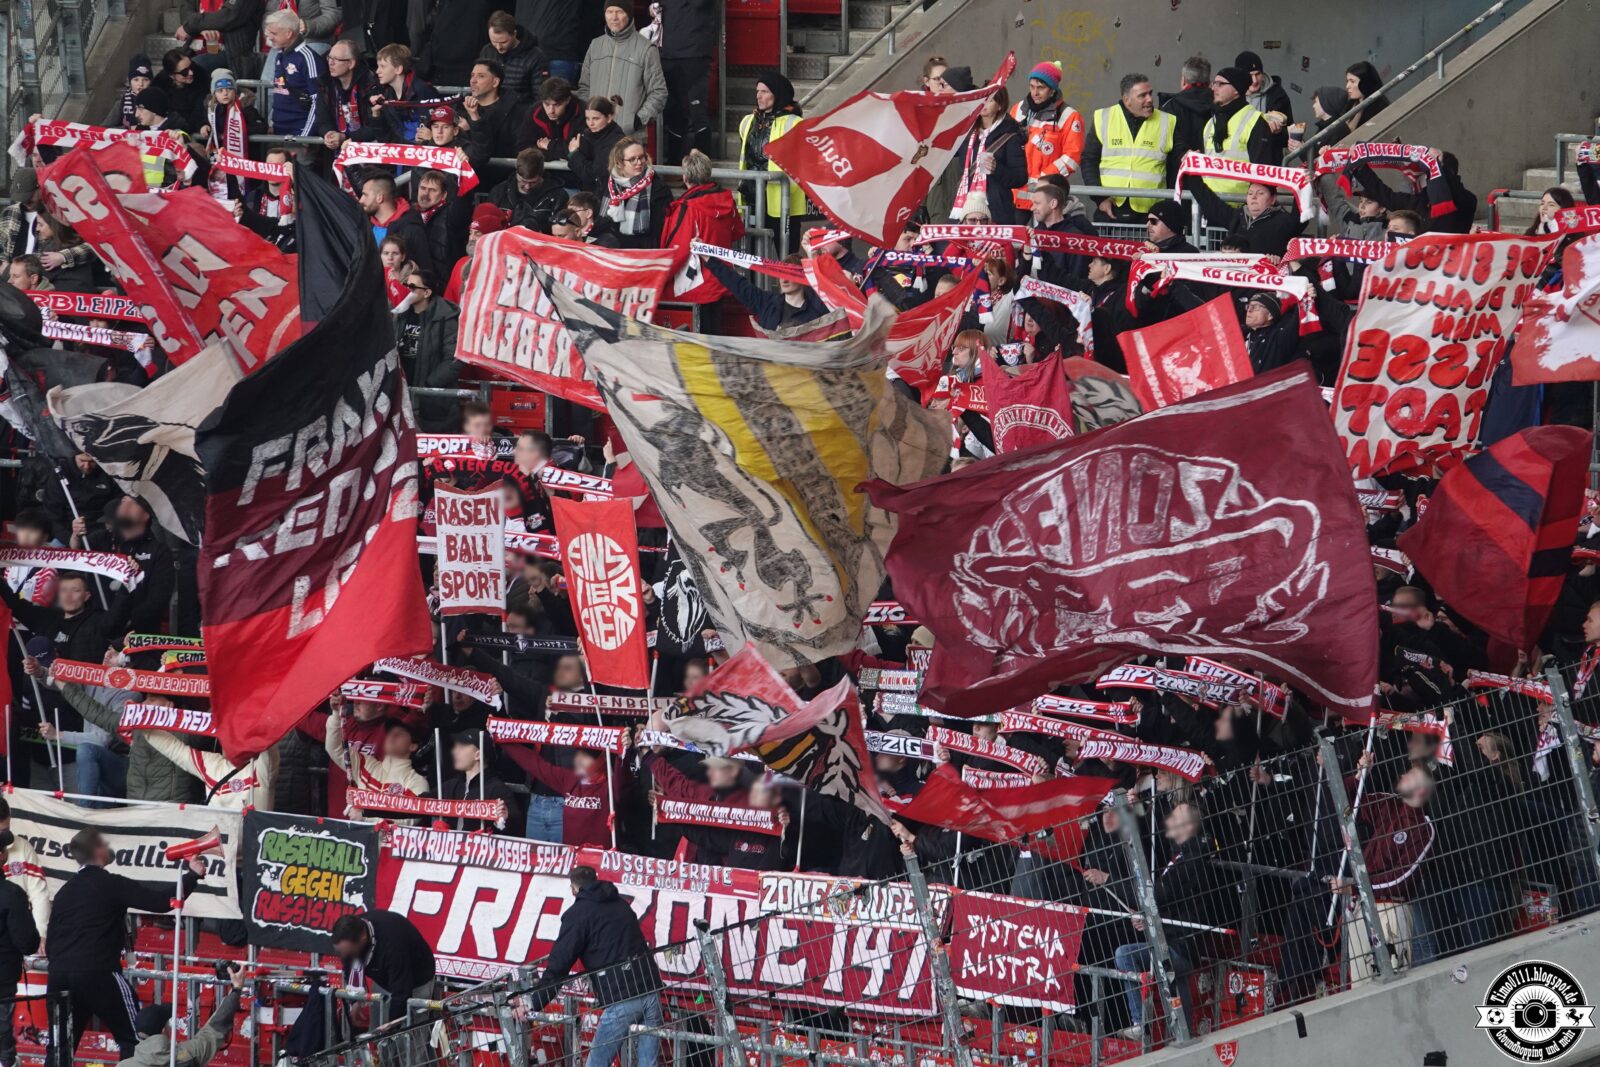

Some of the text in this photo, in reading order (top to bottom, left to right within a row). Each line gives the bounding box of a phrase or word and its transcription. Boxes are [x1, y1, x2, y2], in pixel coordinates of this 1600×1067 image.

[40, 125, 105, 143] ROTEN
[227, 156, 256, 171] ROTEN
[346, 146, 400, 158] ROTEN
[1368, 143, 1400, 157] ROTEN
[1205, 157, 1252, 174] ROTEN
[1257, 165, 1306, 188] BULLEN
[971, 226, 1013, 239] CLUB
[1299, 239, 1330, 256] RB
[76, 296, 144, 318] LEIPZ
[417, 438, 469, 455] SPORT
[437, 498, 500, 526] RASEN
[445, 534, 493, 563] BALL
[567, 533, 631, 582] EINS
[441, 570, 501, 600] SPORT
[55, 663, 104, 683] YOUTH
[179, 710, 212, 732] RED
[578, 727, 622, 751] PRIDE
[262, 831, 364, 875] RASENBALL
[392, 827, 427, 859] STAY
[426, 832, 463, 863] RUDE
[462, 835, 497, 866] STAY
[494, 841, 532, 872] REBEL
[600, 851, 733, 886] AUSGESPERRTE
[280, 865, 345, 902] GEGEN
[761, 877, 828, 917] ZONE
[823, 924, 928, 1000] 147
[961, 948, 1062, 994] ALISTRA
